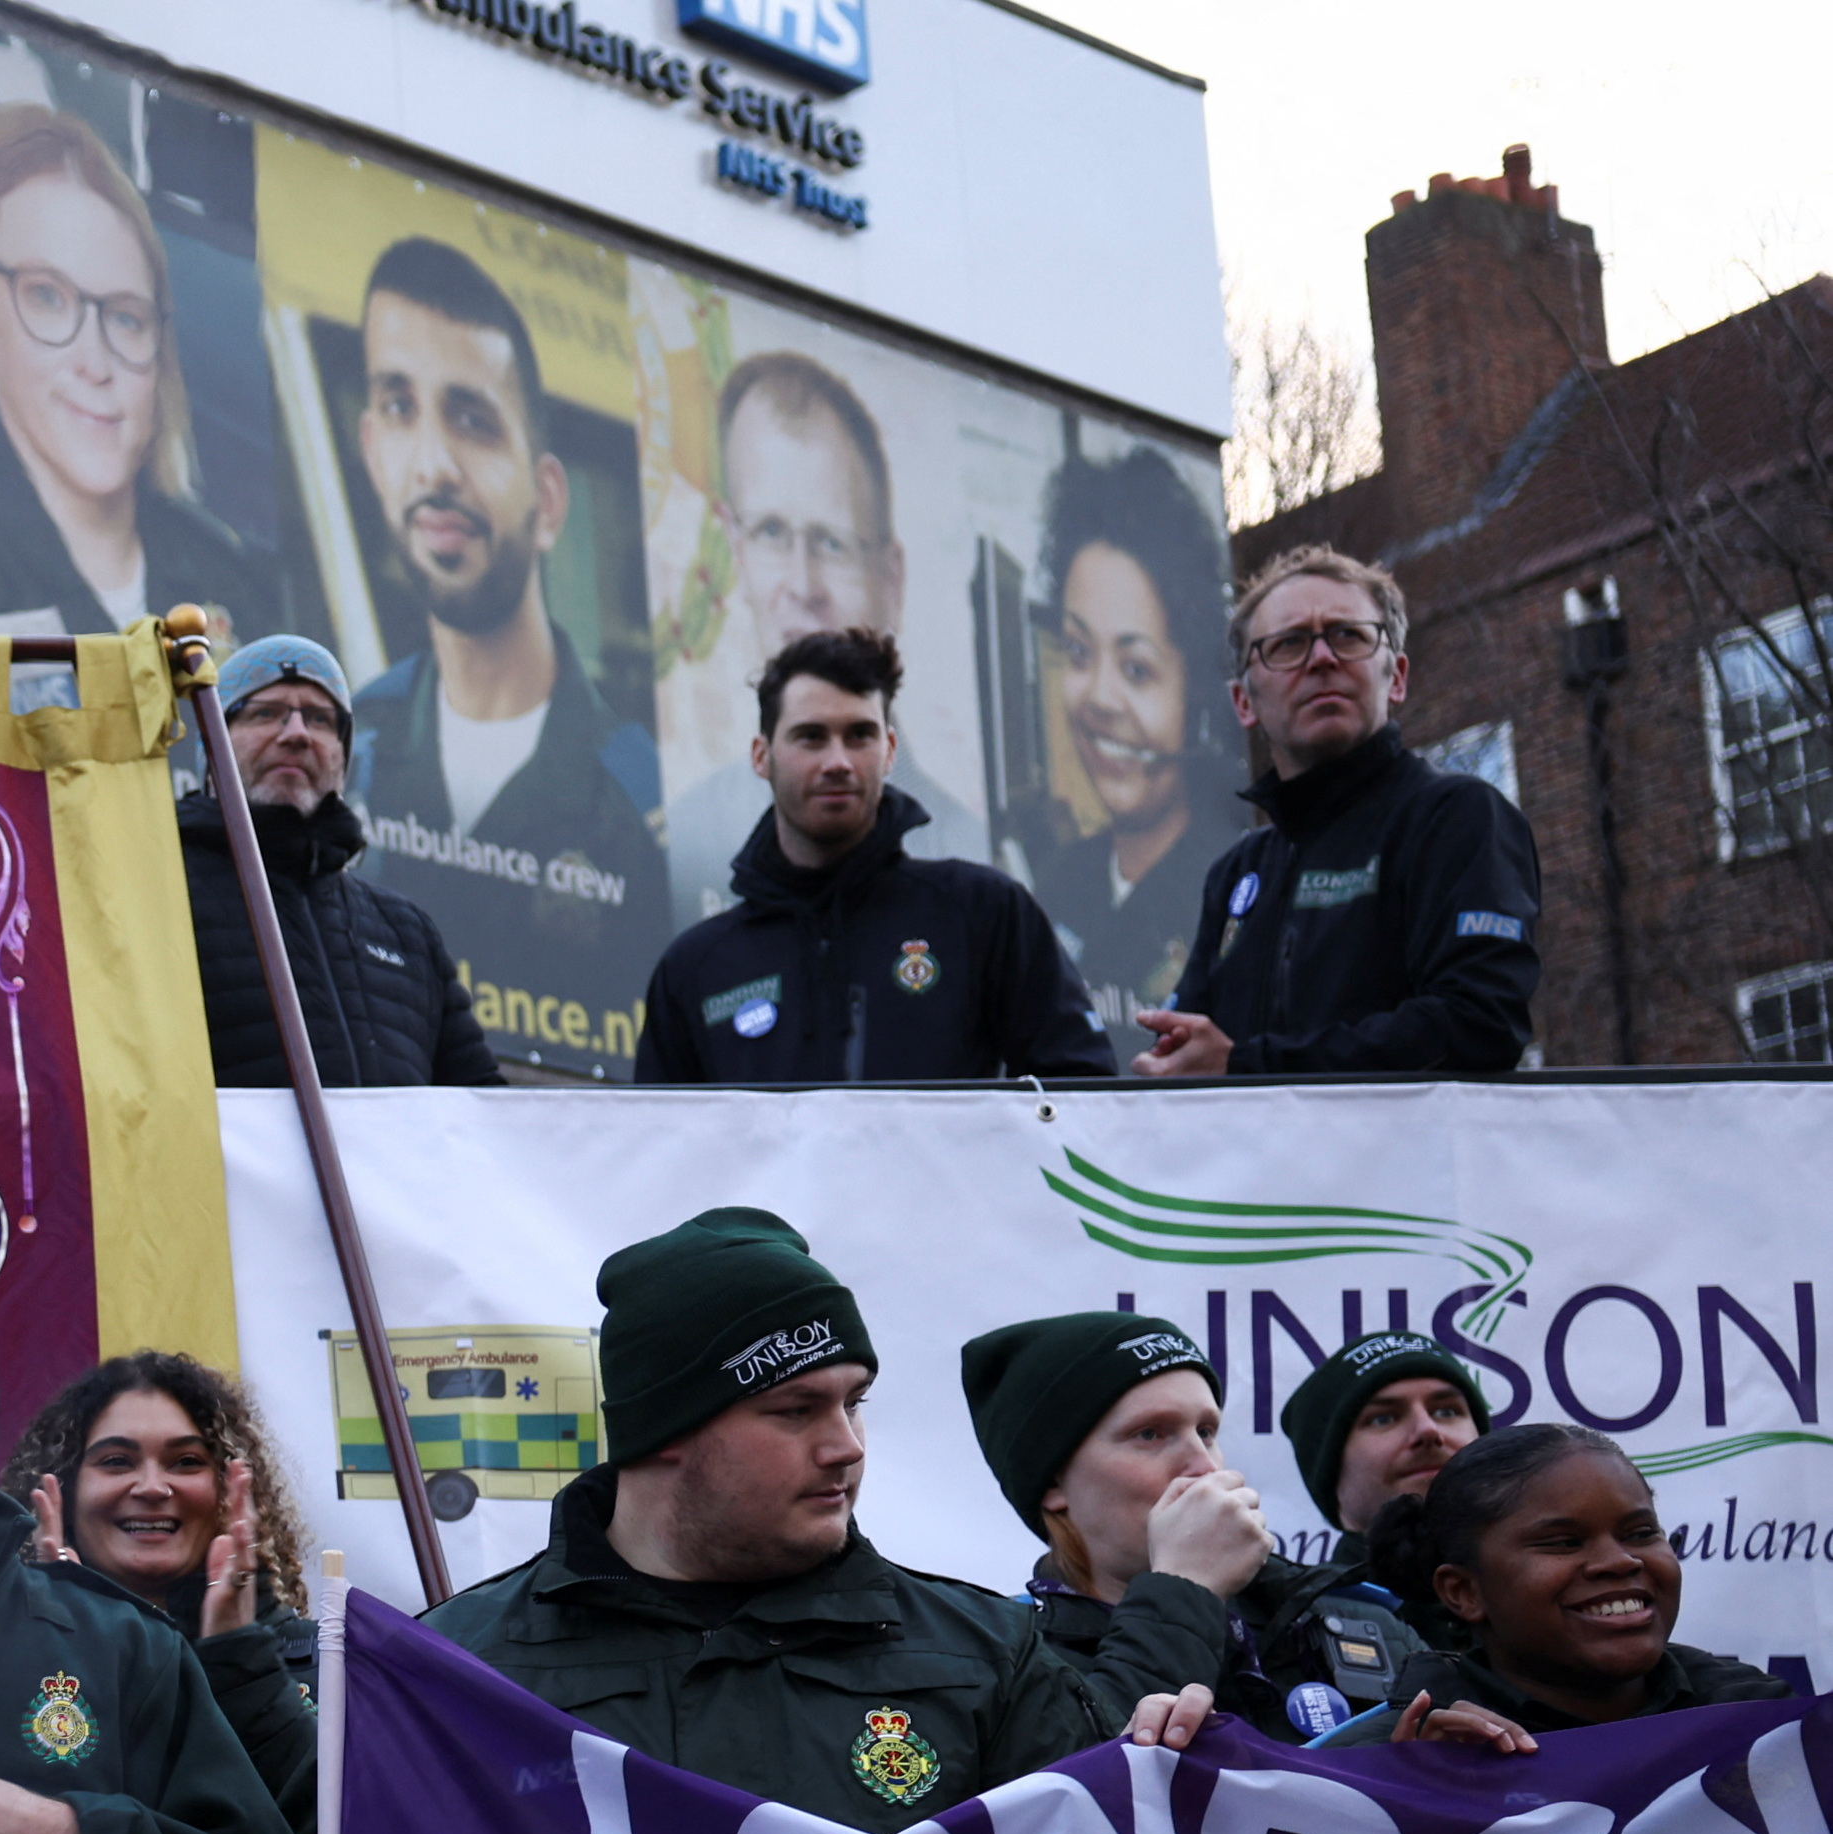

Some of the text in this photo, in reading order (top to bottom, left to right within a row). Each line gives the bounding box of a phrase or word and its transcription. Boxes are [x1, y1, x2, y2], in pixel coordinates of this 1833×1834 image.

[428, 0, 863, 167] mbulance Service
[719, 140, 868, 230] NHS Trust
[358, 802, 540, 887] Ambulance
[545, 858, 627, 907] crew
[1461, 912, 1520, 940] NHS
[394, 1350, 539, 1369] Emergency Ambulance
[735, 1318, 830, 1385] UNISON
